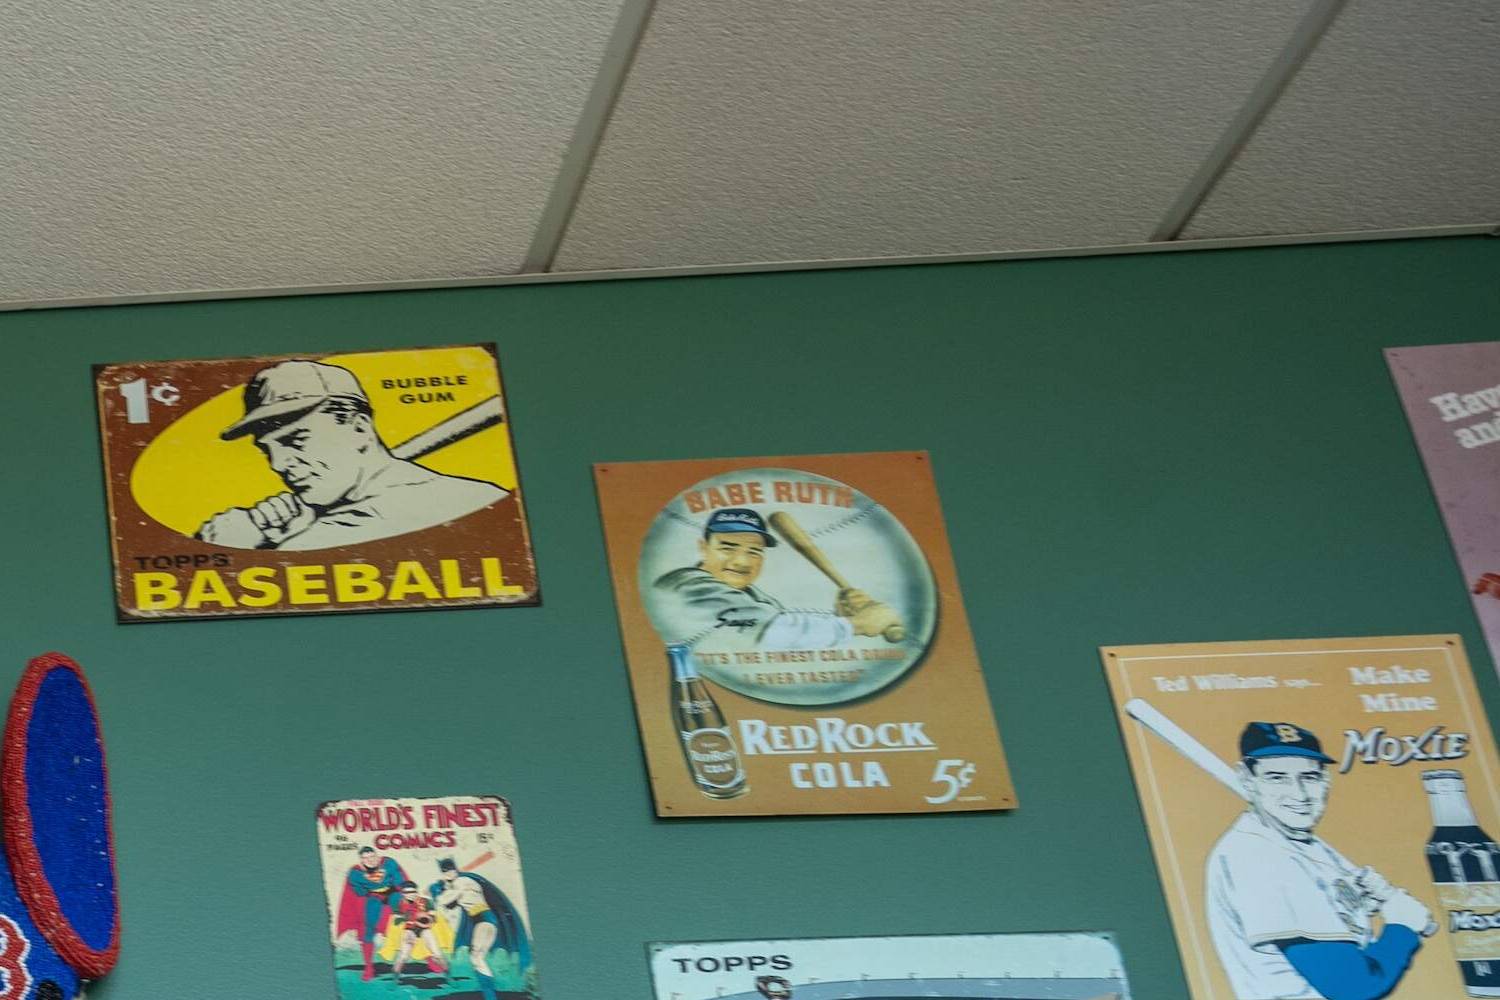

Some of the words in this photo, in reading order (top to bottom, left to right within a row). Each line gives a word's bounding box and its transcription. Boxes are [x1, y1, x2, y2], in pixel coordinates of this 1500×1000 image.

[382, 375, 468, 390] BUBBLE
[400, 391, 455, 405] GUM
[1428, 385, 1500, 422] Hav
[684, 481, 765, 514] BABE
[772, 481, 853, 509] RUTH
[133, 553, 231, 570] TOPPS
[132, 557, 525, 612] BASEBALL
[734, 652, 761, 665] THE
[767, 650, 815, 664] FINEST
[819, 649, 857, 661] COLA
[756, 672, 795, 684] EVER
[1152, 676, 1189, 692] Ted
[1192, 673, 1278, 690] Williams
[1349, 665, 1431, 686] Make
[1359, 693, 1438, 713] Mine
[1276, 724, 1302, 743] B
[789, 761, 892, 789] COLA
[322, 804, 415, 833] WORLD'S
[422, 801, 501, 829] FINEST
[373, 831, 458, 850] COMICS
[671, 954, 793, 975] TOPPS
